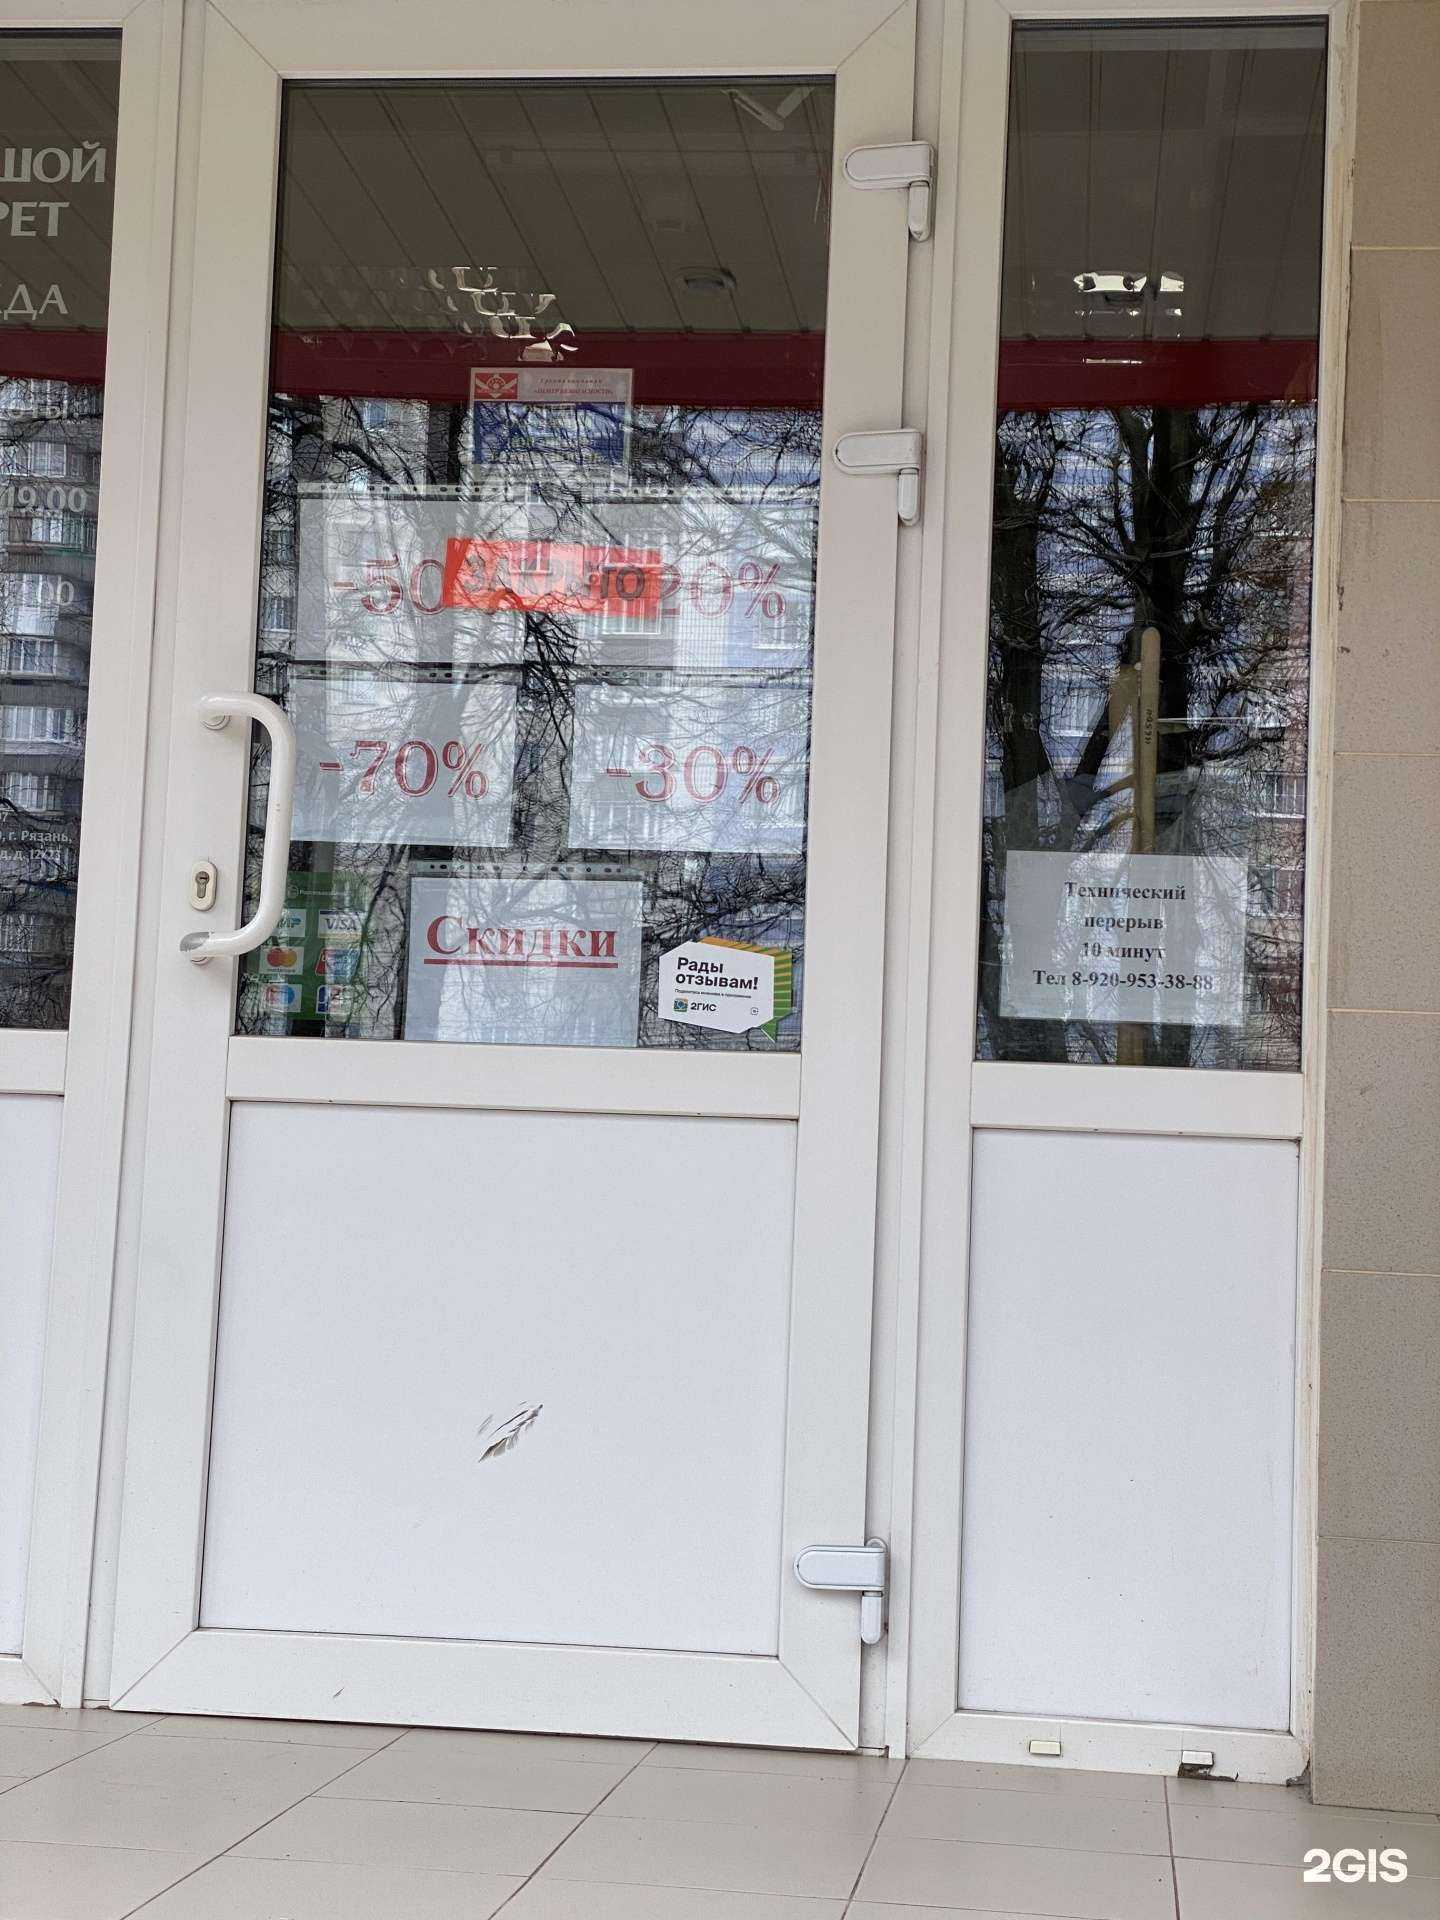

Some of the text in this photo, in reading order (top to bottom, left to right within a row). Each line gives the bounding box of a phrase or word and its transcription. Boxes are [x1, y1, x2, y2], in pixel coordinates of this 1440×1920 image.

[0, 284, 69, 321] ДА
[318, 739, 491, 800] -70%
[606, 742, 782, 805] -30%
[21, 830, 73, 843] Рязань,
[1064, 880, 1186, 900] Технический
[325, 918, 358, 930] VISA
[1084, 916, 1164, 932] перерыв
[1083, 942, 1165, 962] 10 минут
[677, 957, 723, 974] Рады
[675, 973, 759, 990] отзывам!
[1072, 972, 1214, 990] 8-920-953-38-88
[690, 1002, 717, 1012] 2ГИС
